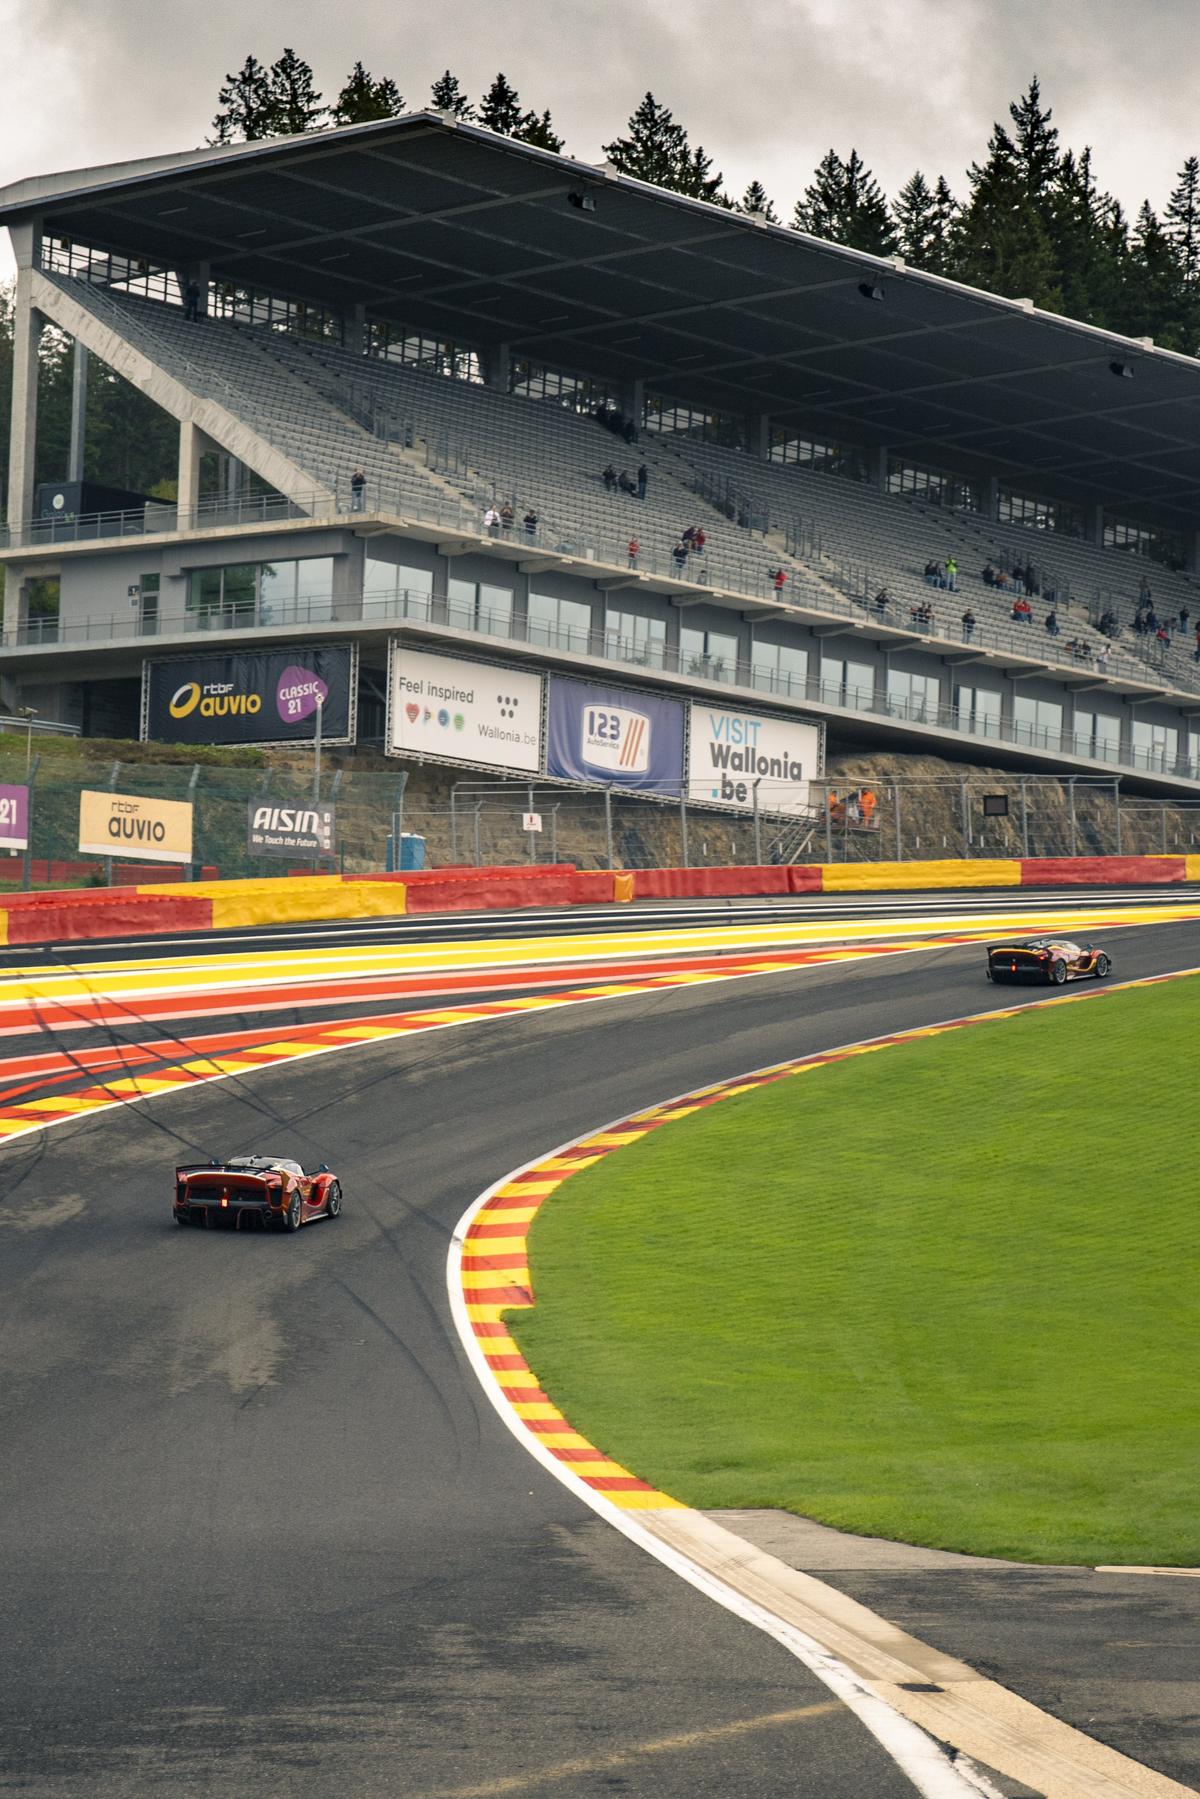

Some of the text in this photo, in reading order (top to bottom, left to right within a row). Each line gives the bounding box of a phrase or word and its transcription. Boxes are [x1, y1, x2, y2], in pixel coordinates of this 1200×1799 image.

[279, 681, 319, 700] CLASSIC
[399, 677, 474, 704] Feel inspired
[288, 699, 302, 714] 21
[478, 723, 537, 746] Wallonia.be
[709, 714, 762, 746] VISIT
[709, 742, 802, 780] Wallonia
[0, 798, 17, 825] 21
[253, 807, 319, 834] AISIN
[252, 834, 264, 843] We
[264, 835, 284, 846] Touch
[296, 838, 317, 848] Future
